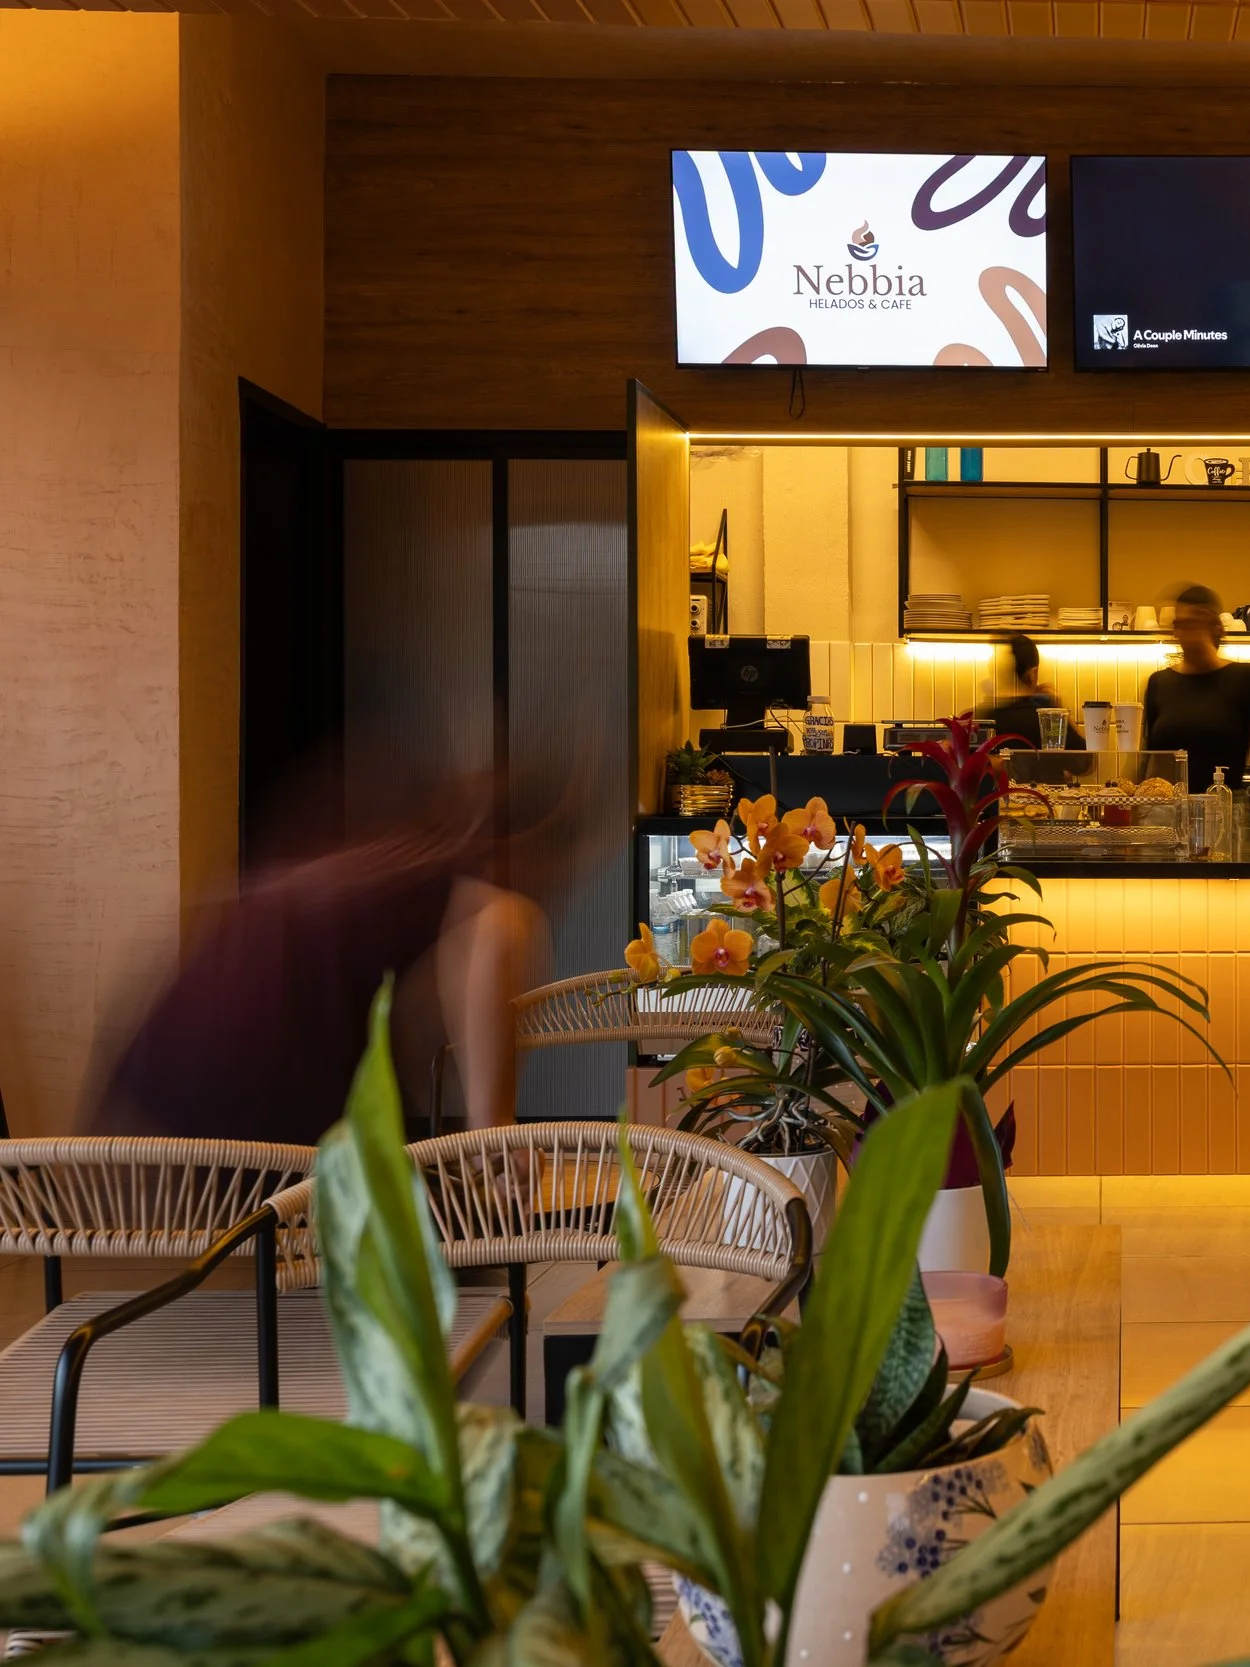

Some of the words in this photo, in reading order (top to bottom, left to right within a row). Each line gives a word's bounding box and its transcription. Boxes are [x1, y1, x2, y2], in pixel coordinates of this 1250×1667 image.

[793, 263, 927, 296] Nebbia
[809, 298, 865, 309] HELADOS
[868, 299, 878, 310] &
[880, 299, 912, 310] CAFE
[1133, 330, 1143, 340] A
[1143, 329, 1182, 342] Couple
[1183, 329, 1228, 341] Minutes
[805, 715, 834, 726] GRACIAS
